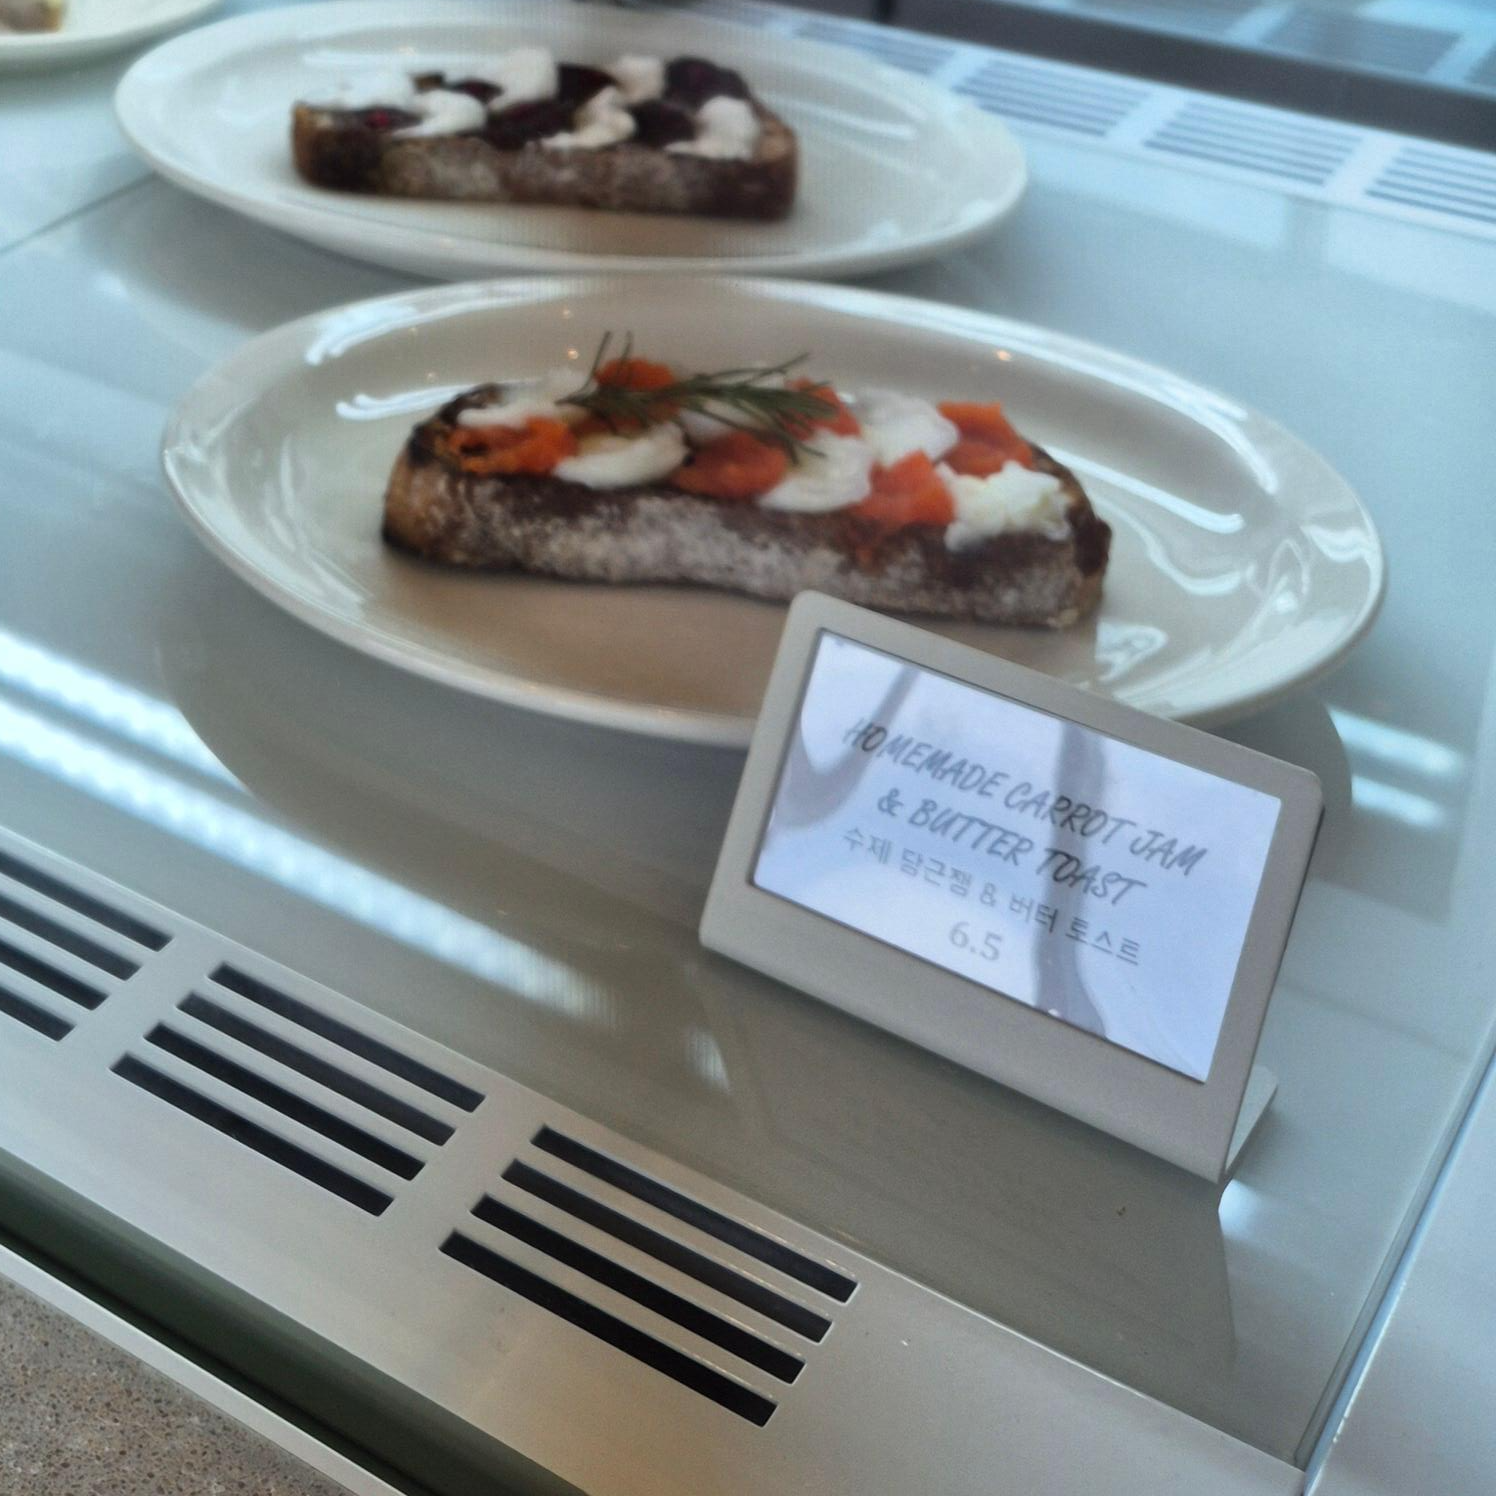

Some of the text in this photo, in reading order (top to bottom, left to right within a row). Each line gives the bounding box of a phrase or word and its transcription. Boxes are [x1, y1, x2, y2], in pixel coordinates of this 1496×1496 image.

[842, 717, 1208, 878] HOMEMADE CARROT JAM
[876, 786, 1147, 908] & BUTTER TOAST
[841, 826, 893, 866] 수제
[1008, 894, 1061, 934] 버터
[1065, 915, 1142, 967] 토스트
[947, 920, 1004, 963] 6.5
